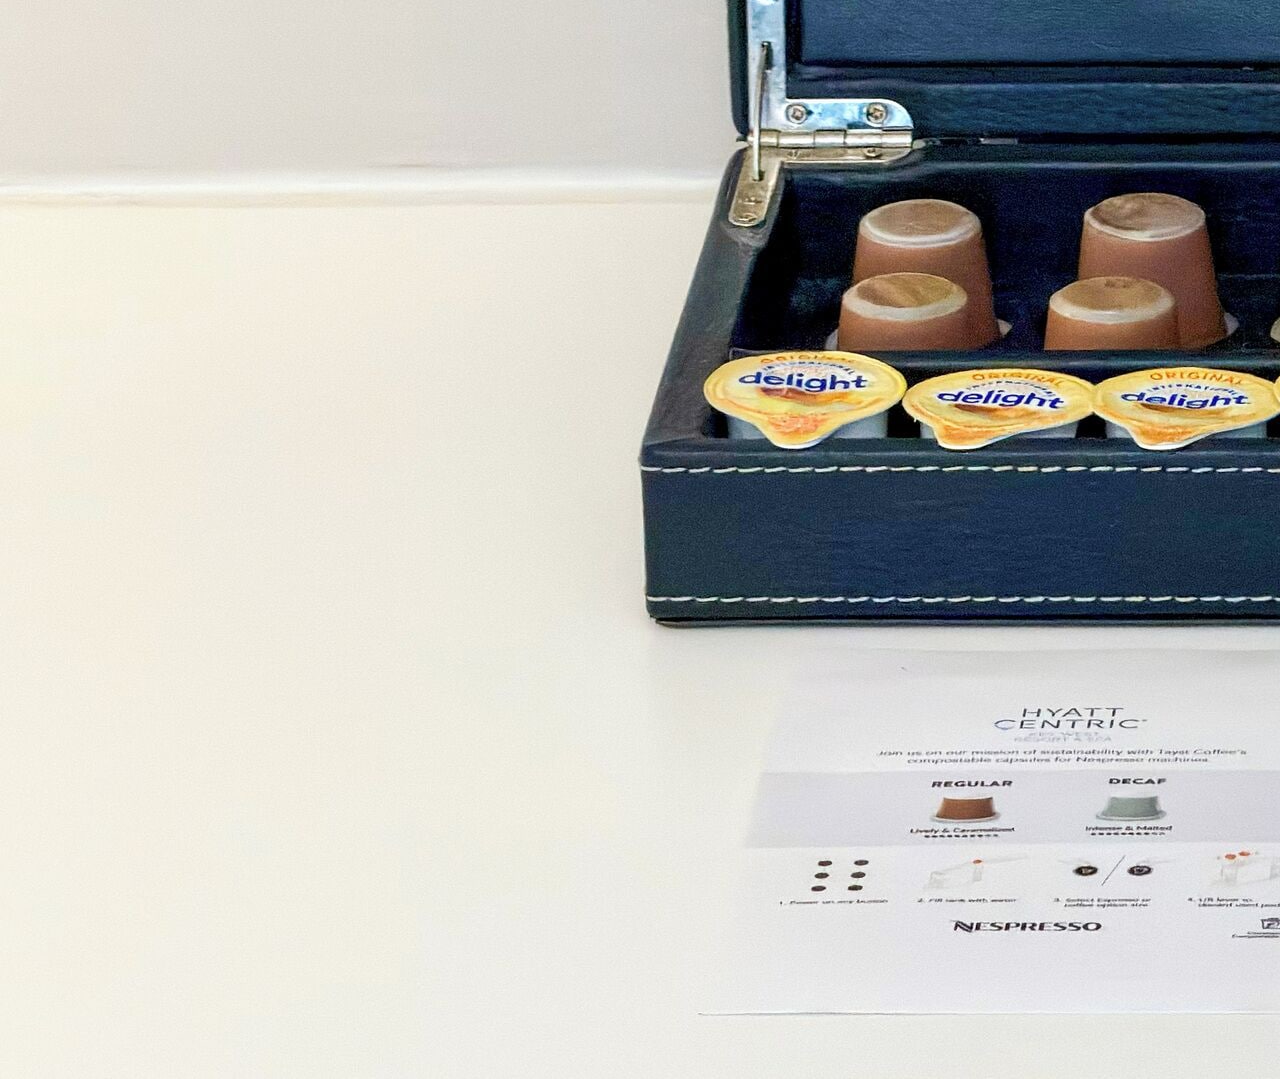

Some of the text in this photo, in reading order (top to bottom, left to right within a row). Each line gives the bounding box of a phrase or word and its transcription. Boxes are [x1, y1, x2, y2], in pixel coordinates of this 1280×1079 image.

[739, 372, 867, 392] delight
[1150, 371, 1241, 384] ORIGINAL
[937, 390, 1064, 409] delight
[1121, 392, 1248, 409] delight
[1022, 707, 1124, 717] HYATT
[994, 719, 1140, 729] CENTRIC
[931, 780, 1013, 788] REGULAR
[1109, 777, 1168, 785] DECAF
[952, 920, 1102, 933] NESPRESSO
